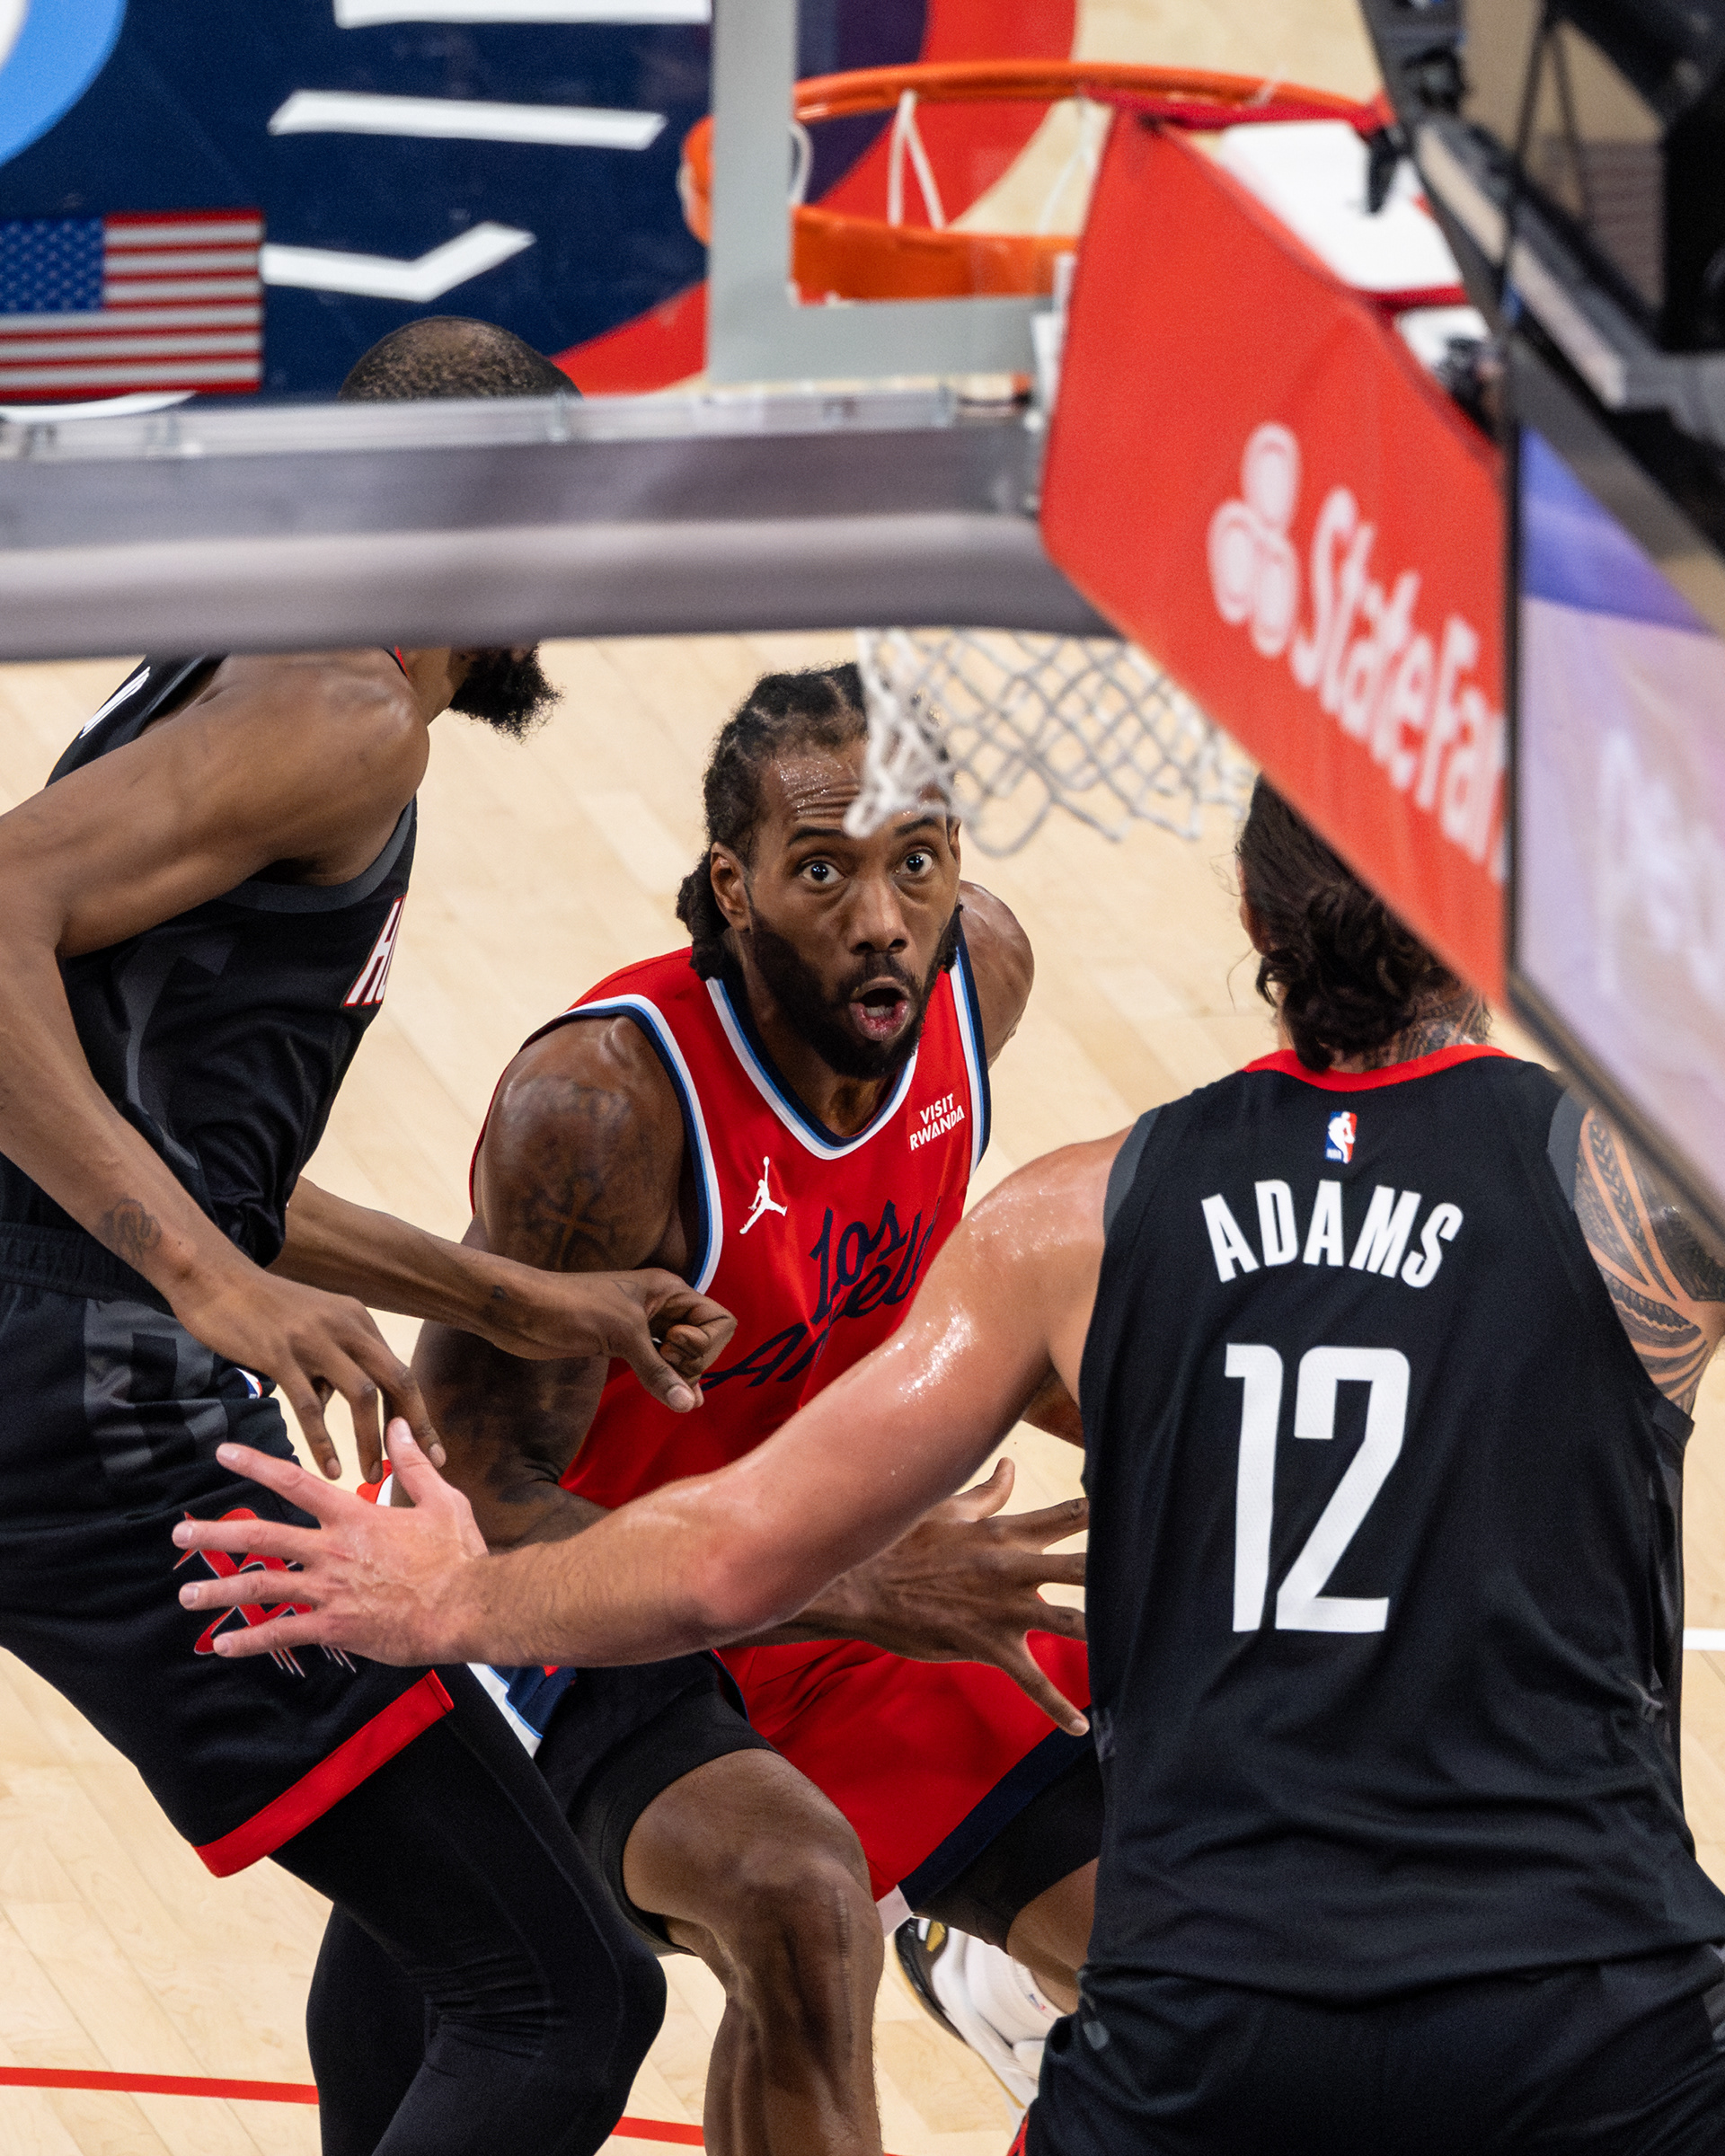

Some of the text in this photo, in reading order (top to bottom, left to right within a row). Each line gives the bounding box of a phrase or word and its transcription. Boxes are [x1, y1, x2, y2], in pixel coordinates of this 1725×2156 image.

[909, 1105, 966, 1152] RWANDA
[919, 1092, 954, 1125] VISIT
[1201, 1179, 1464, 1288] ADAMS
[1224, 1343, 1411, 1633] 12
